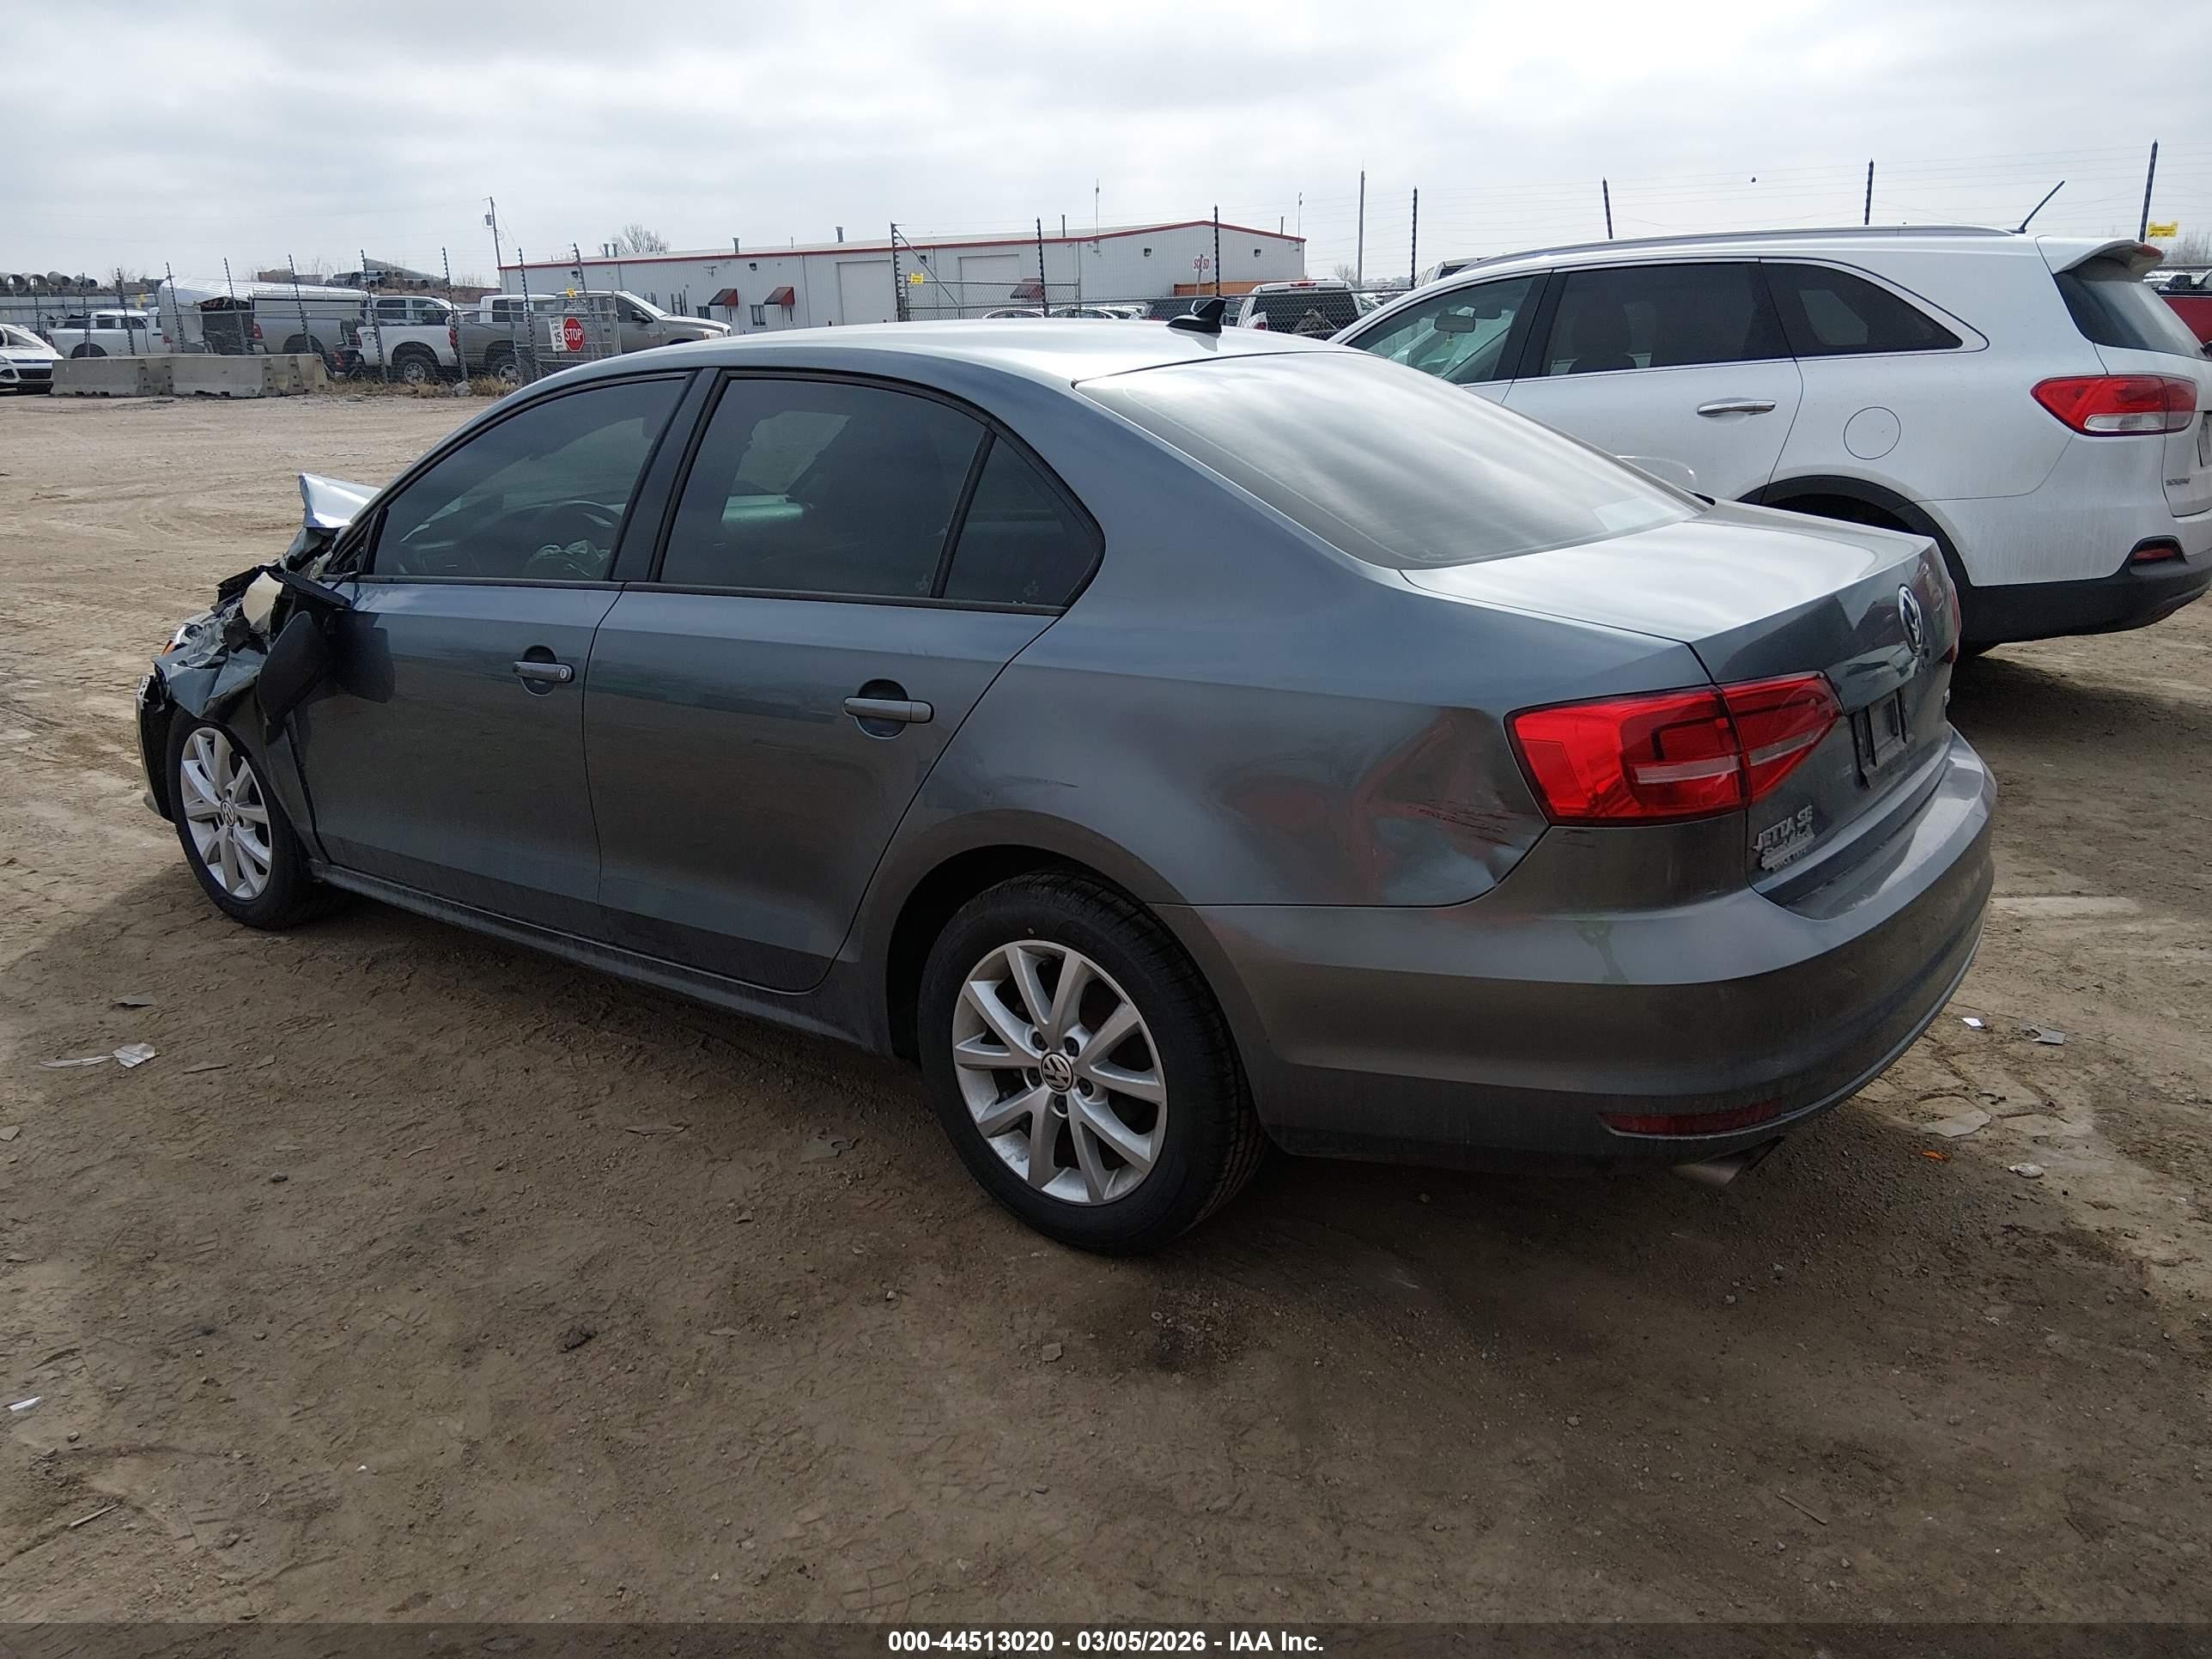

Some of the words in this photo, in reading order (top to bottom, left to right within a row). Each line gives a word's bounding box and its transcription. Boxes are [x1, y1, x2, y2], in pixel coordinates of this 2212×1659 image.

[555, 331, 562, 343] 15
[564, 328, 582, 341] STOP
[1752, 817, 1796, 852] JETTA
[1796, 805, 1813, 827] SE
